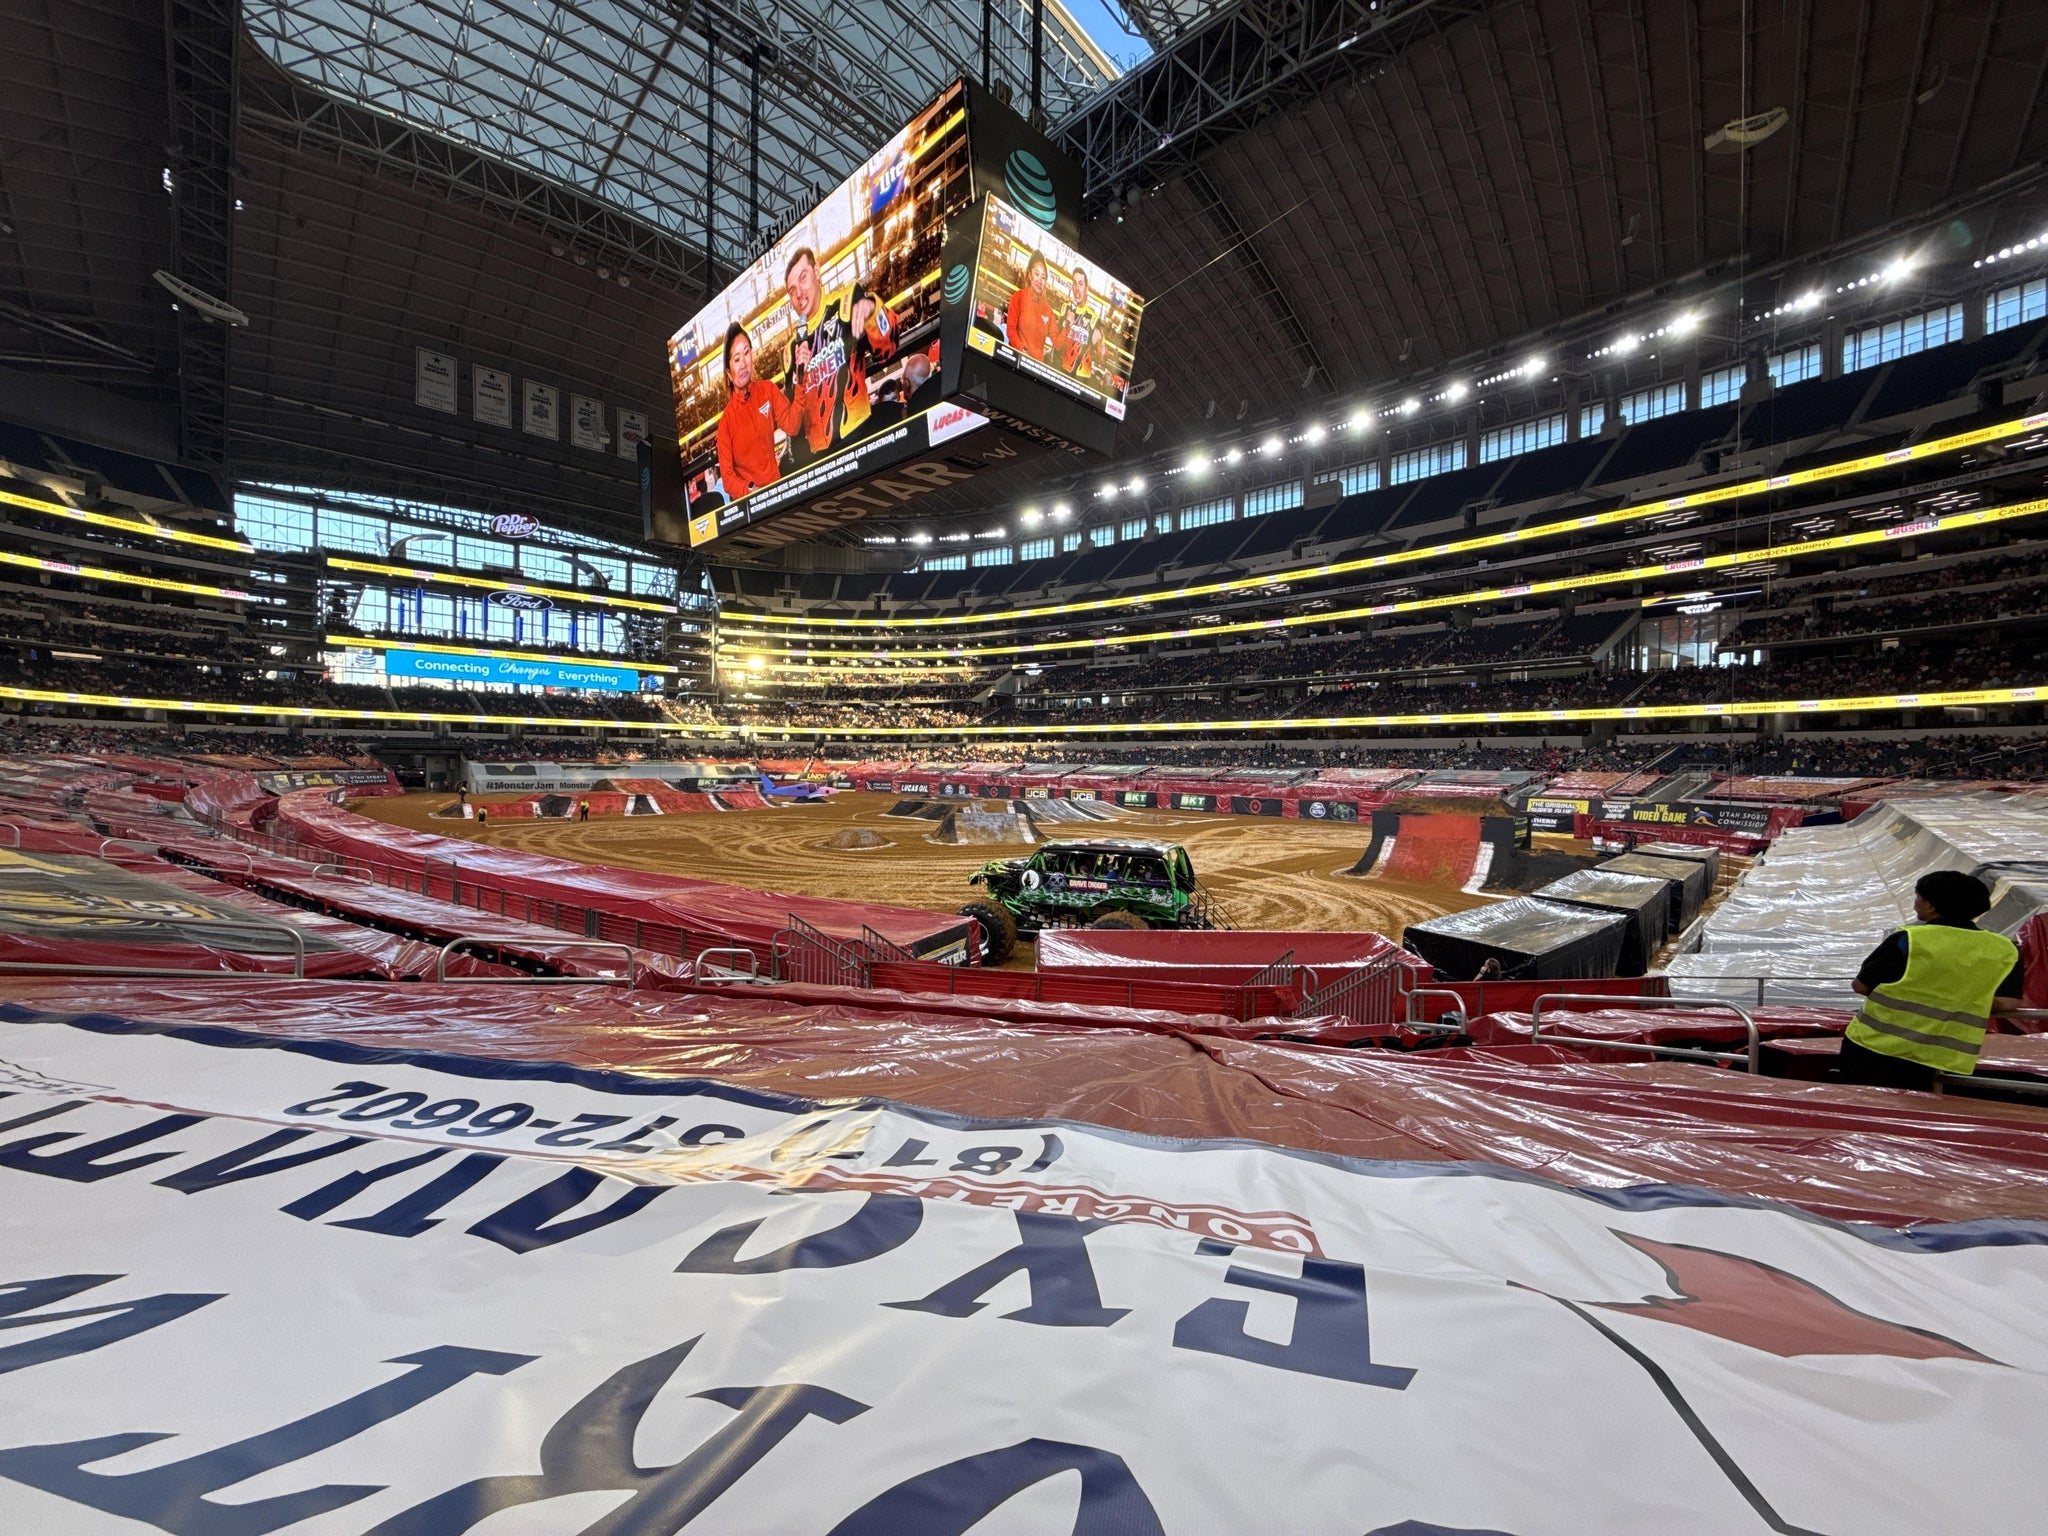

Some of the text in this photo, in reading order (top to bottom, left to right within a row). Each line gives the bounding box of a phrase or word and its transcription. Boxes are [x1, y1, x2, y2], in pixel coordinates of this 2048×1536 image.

[770, 181, 821, 243] STADIUM
[933, 408, 964, 432] LUCAS
[981, 407, 1086, 455] WINSTAR
[1914, 482, 1939, 492] TONY
[732, 462, 975, 549] WINSTAR
[1998, 500, 2048, 516] CAMDE
[495, 515, 536, 534] Pepper
[510, 513, 527, 525] Dr
[1722, 521, 1738, 529] TOM
[1885, 519, 1939, 537] CRUSHER
[1747, 540, 1832, 559] CAMDEN MURPHY
[1664, 559, 1704, 571] CRUSHER
[119, 574, 151, 584] CAMDEN
[1563, 577, 1593, 587] CAMDEN
[500, 592, 543, 610] Ford
[415, 657, 618, 686] Connecting Changes Everything
[486, 780, 554, 790] #MonsterJam
[901, 784, 929, 793] LUCAS OIL
[1027, 789, 1046, 798] JCB
[1073, 792, 1094, 801] JCB
[1125, 792, 1147, 802] BKT
[1181, 795, 1206, 806] BKT
[1655, 804, 1669, 812] THE
[1633, 810, 1660, 821] VIDEO
[1661, 811, 1688, 824] GAME
[1742, 812, 1768, 821] SPORTS
[1717, 818, 1766, 828] COMMISSION
[1069, 879, 1108, 890] GRAVE DIGGER
